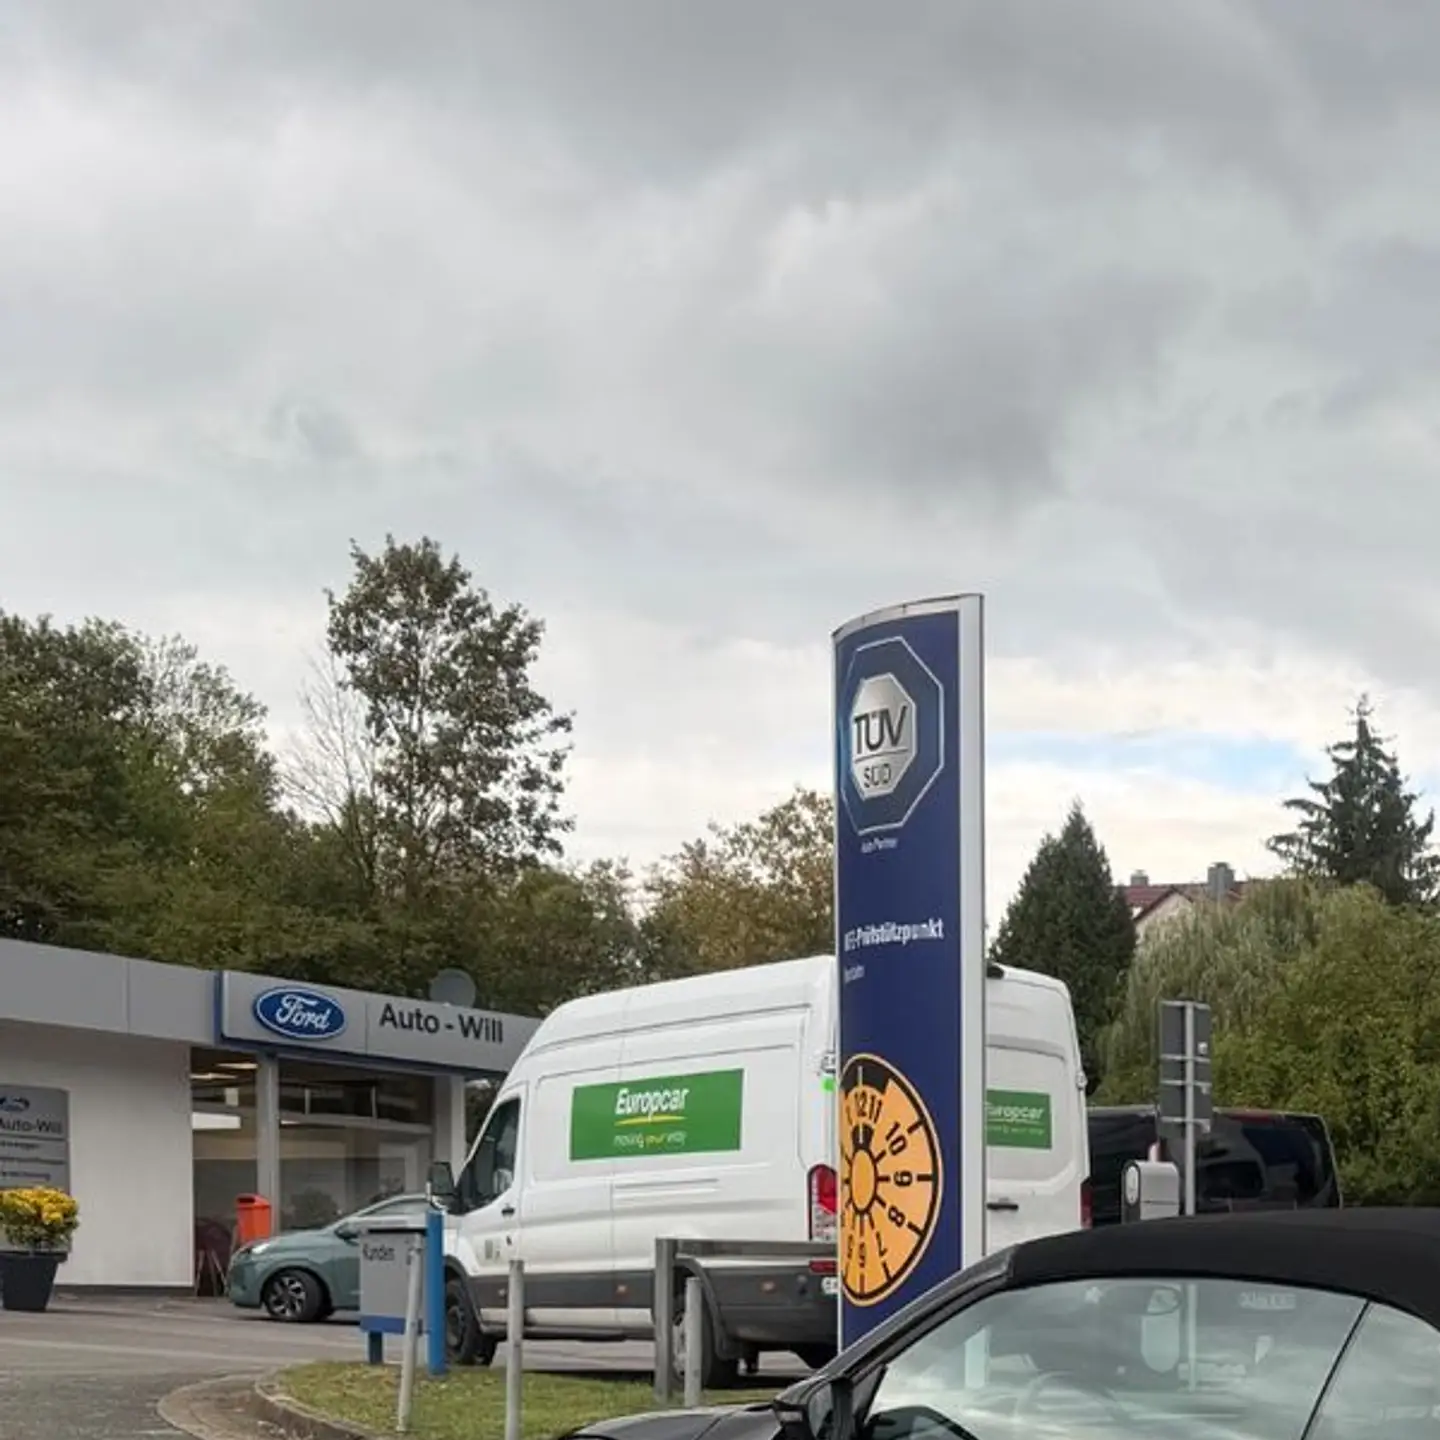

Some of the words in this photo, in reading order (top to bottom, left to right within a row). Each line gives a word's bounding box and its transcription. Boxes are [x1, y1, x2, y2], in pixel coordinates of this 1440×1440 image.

[854, 705, 909, 754] TÜV
[863, 763, 892, 789] SÜD
[275, 993, 331, 1031] Ford
[379, 1003, 440, 1034] Auto
[458, 1013, 503, 1043] Will
[615, 1087, 690, 1122] Europcar
[885, 1121, 908, 1156] 10
[888, 1205, 906, 1228] 8
